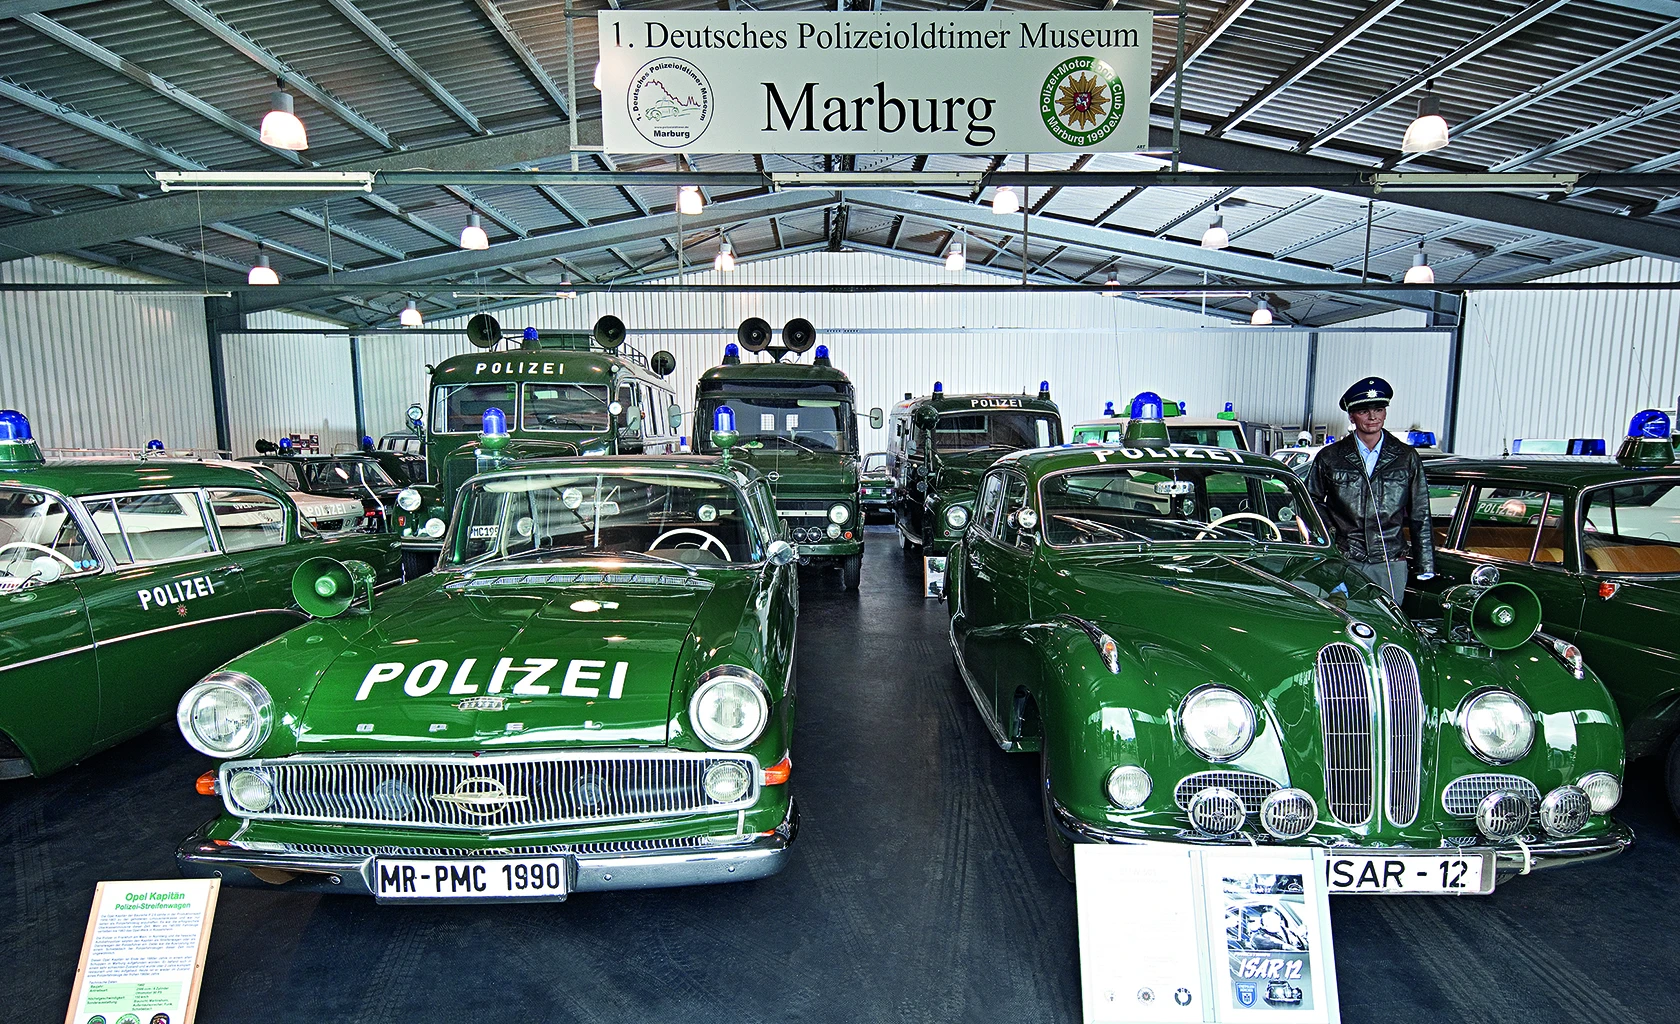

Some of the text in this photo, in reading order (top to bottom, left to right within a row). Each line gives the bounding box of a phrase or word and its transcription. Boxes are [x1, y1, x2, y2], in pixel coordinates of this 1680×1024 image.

[613, 21, 1139, 50] 1. Deutsches Polizeioldtimer Museum
[633, 72, 650, 112] Deutsches
[649, 62, 703, 86] Polizeioldtimer
[700, 87, 708, 122] Museum
[761, 82, 997, 147] Marburg
[653, 130, 690, 139] Marburg
[1047, 116, 1085, 145] Marburg
[475, 362, 565, 375] POLIZEI
[971, 399, 1023, 408] POLIZEI
[1092, 446, 1244, 463] POLIZEI
[307, 503, 347, 516] POLIZEI
[1477, 502, 1517, 517] POLIZEI
[136, 575, 216, 611] POLIZEI
[355, 657, 629, 701] POLIZEI
[502, 863, 560, 891] 1990
[1325, 860, 1406, 888] ISAR
[115, 902, 191, 911] Polizei-Streifenwagen
[125, 892, 185, 903] Opel Kapitän
[1239, 958, 1303, 980] ISAR 12
